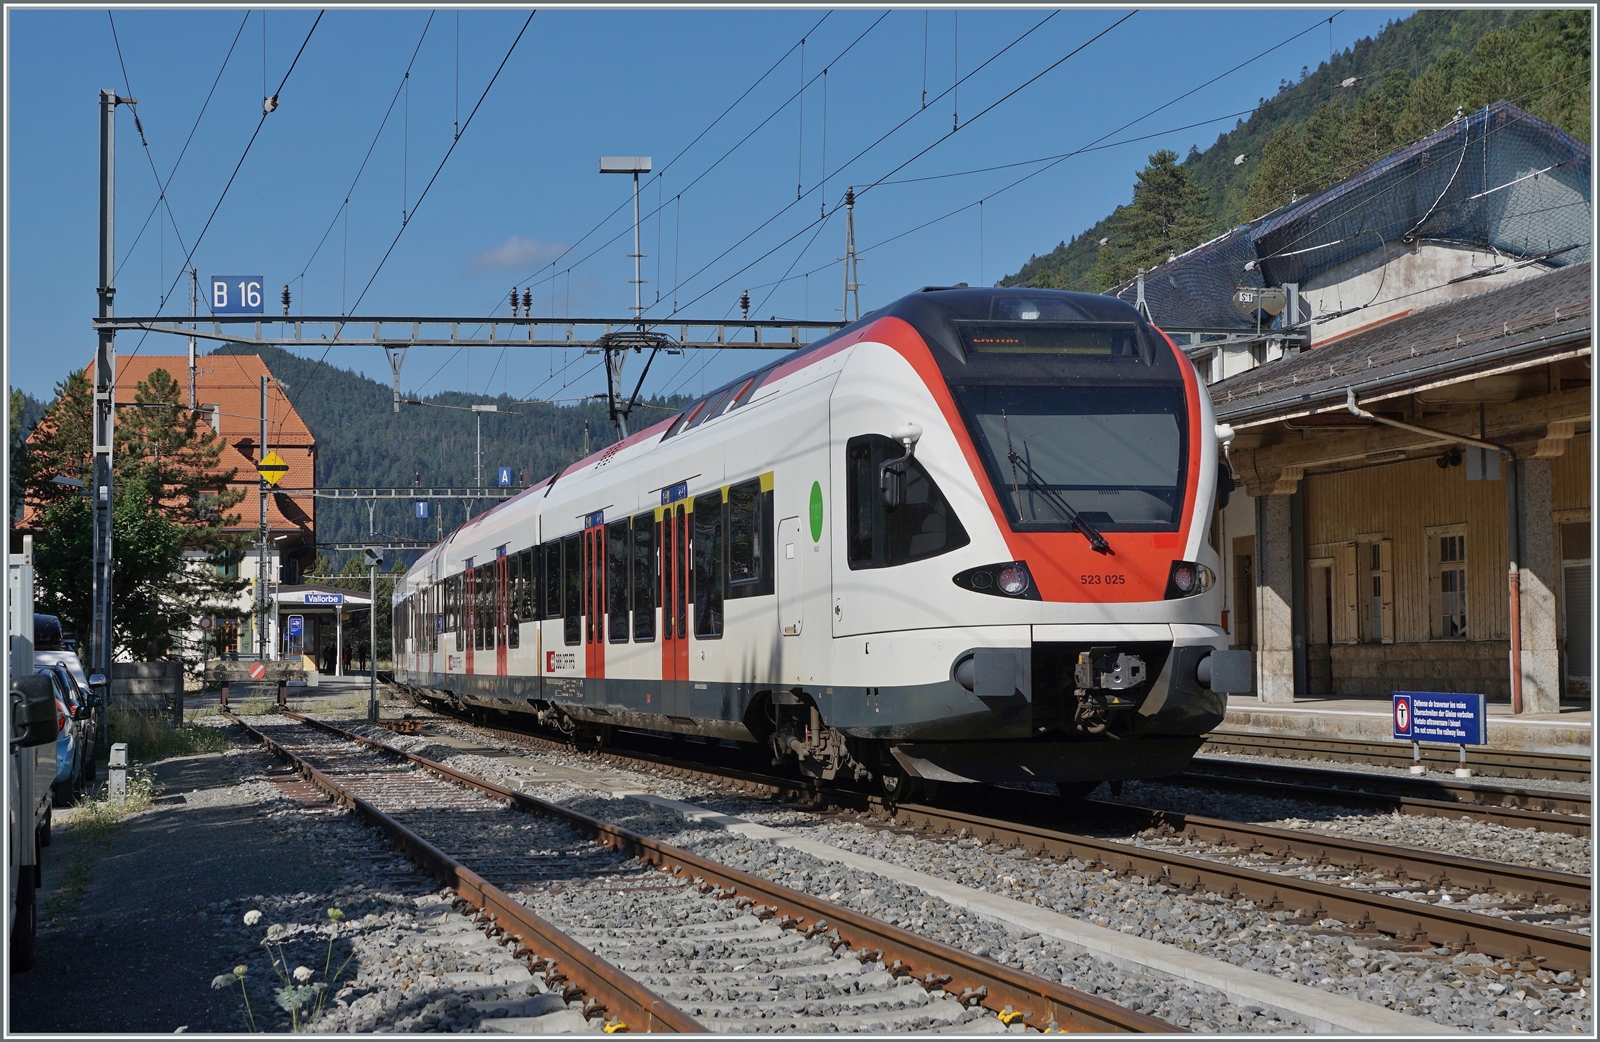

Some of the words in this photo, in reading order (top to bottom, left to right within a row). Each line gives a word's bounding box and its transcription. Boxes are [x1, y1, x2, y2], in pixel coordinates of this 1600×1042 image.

[213, 281, 228, 307] B
[238, 281, 261, 307] 16
[501, 469, 509, 483] A
[419, 502, 424, 516] 1
[1080, 574, 1102, 585] 523
[1104, 574, 1126, 585] 025
[308, 595, 339, 603] Vallorbe
